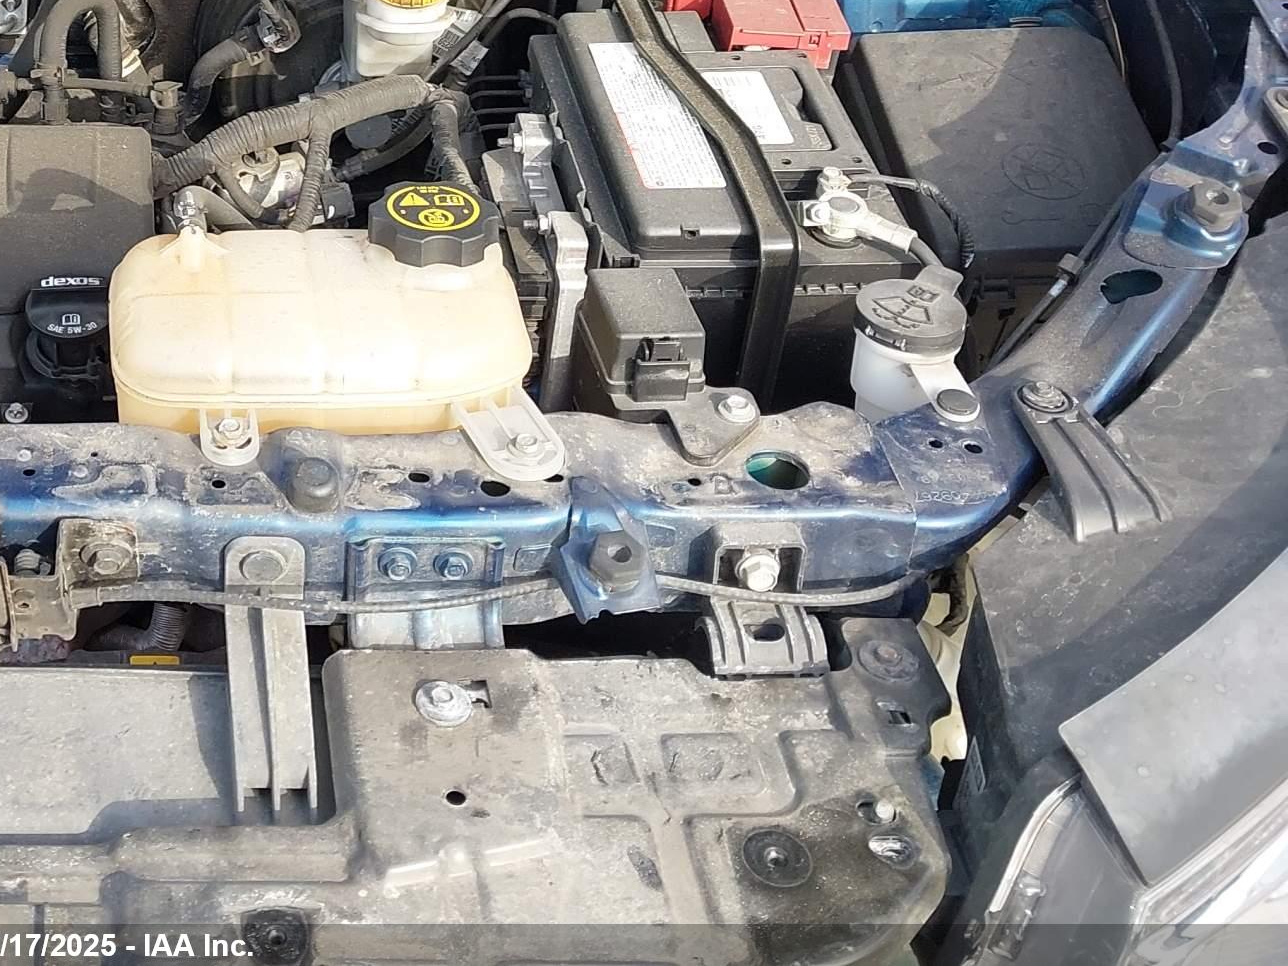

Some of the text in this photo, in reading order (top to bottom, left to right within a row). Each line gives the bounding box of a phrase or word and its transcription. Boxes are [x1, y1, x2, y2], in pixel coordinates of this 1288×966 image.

[40, 276, 103, 288] dexos
[47, 321, 98, 334] SAE 5W-30
